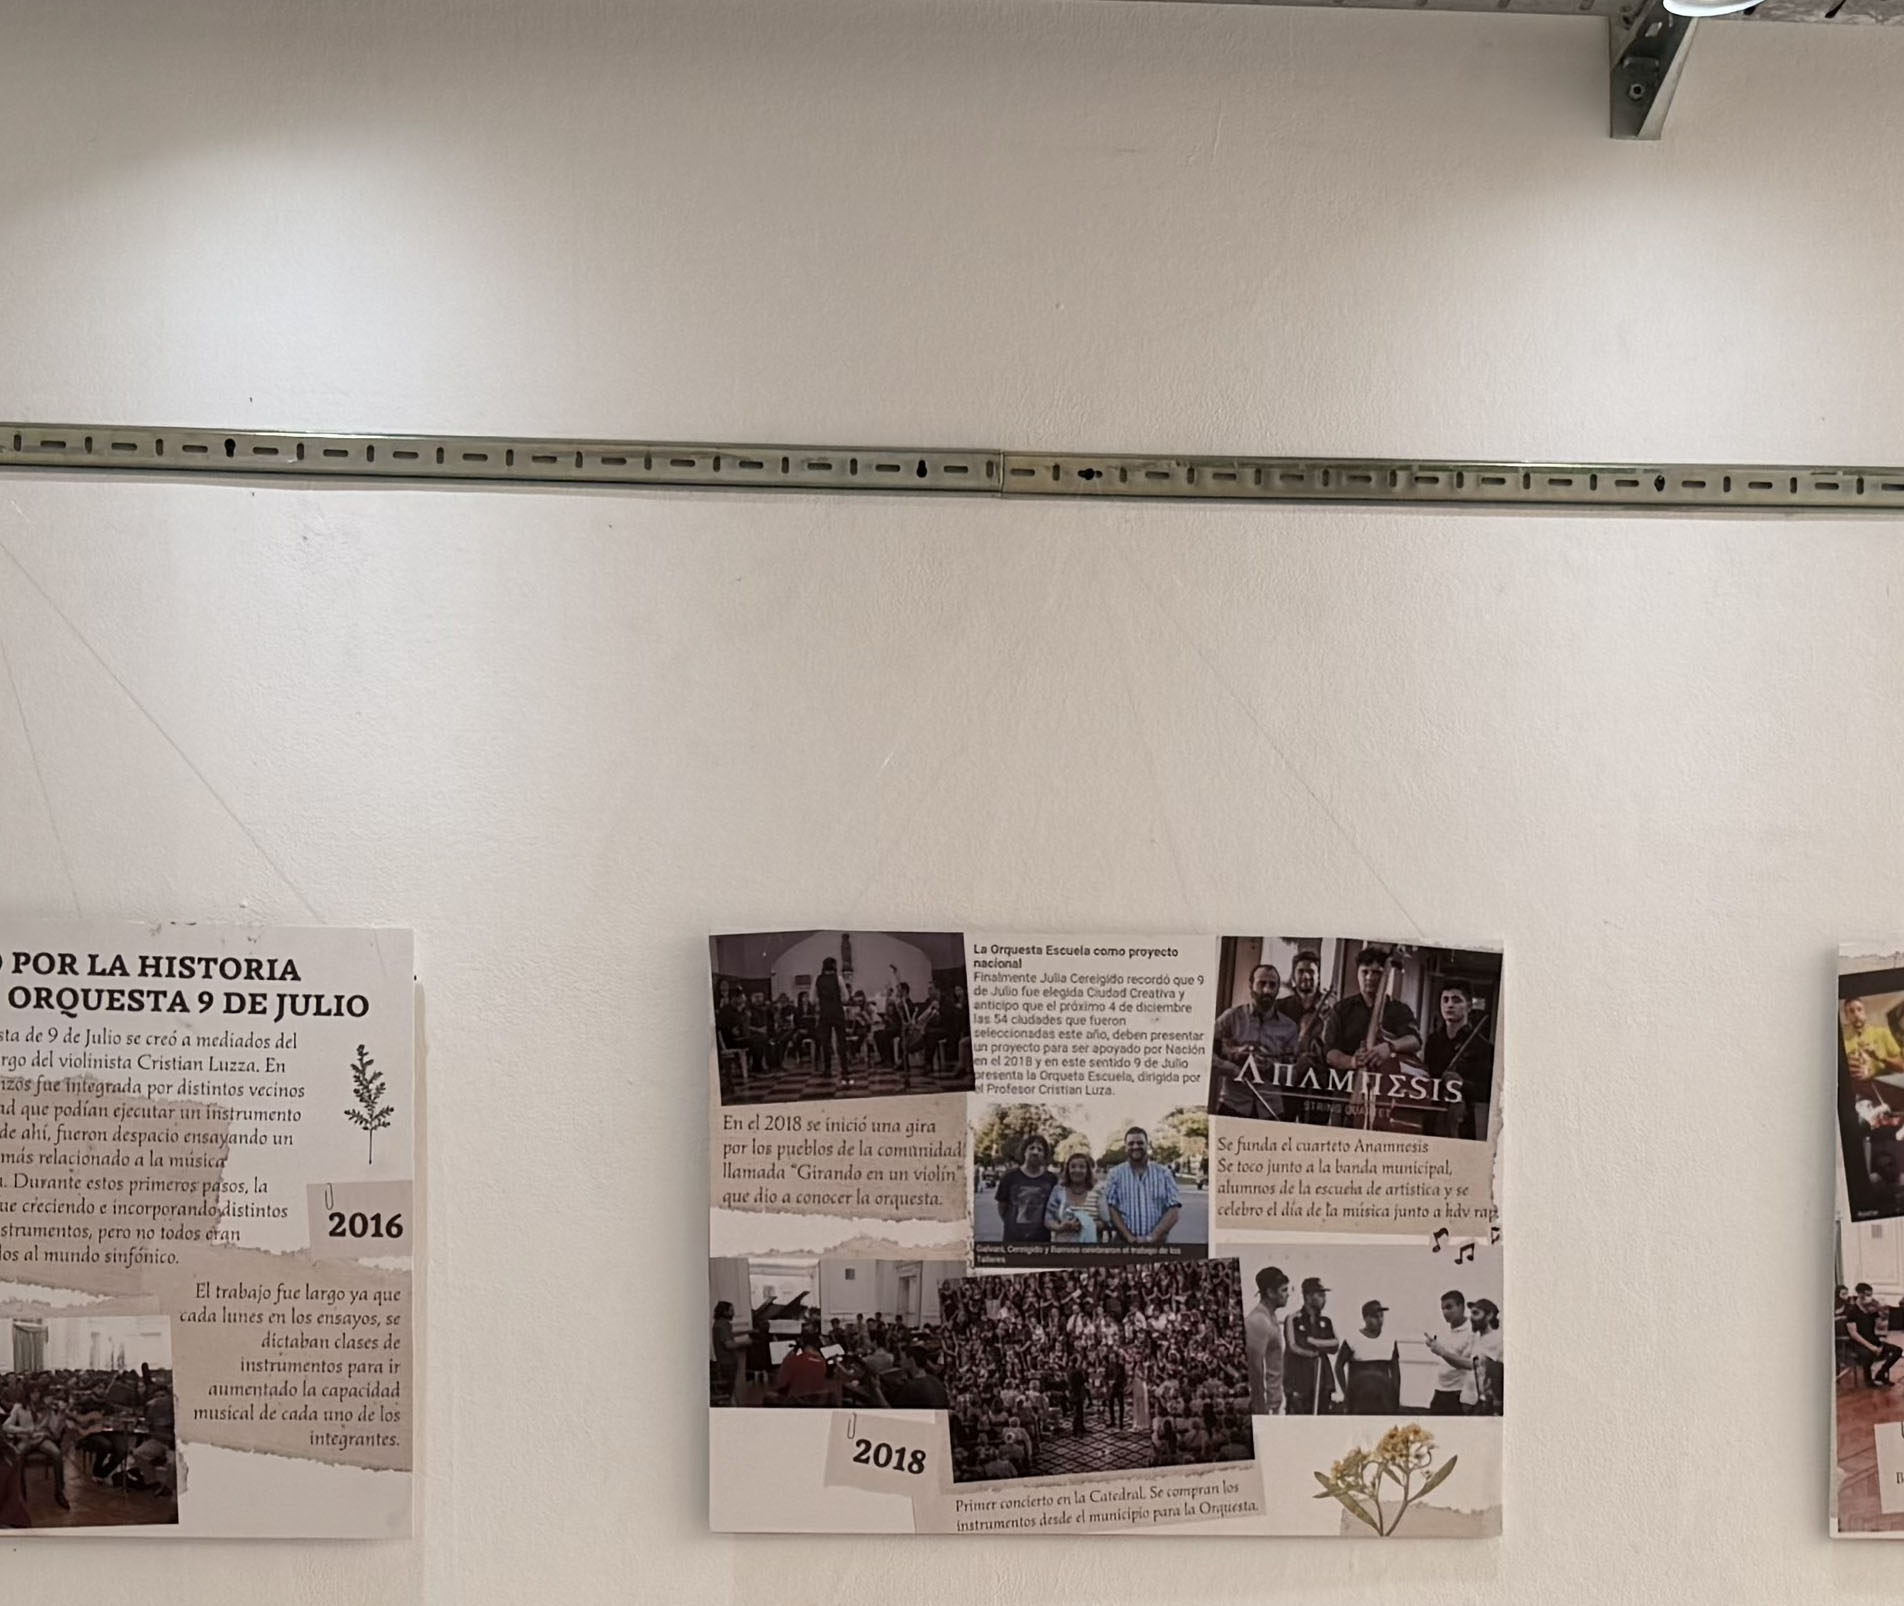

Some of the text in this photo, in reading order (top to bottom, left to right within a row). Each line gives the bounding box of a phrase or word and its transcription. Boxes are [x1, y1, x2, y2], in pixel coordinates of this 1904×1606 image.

[973, 943, 1179, 960] La Orquesta Escuela como proyecto
[973, 957, 1023, 969] nacional
[11, 951, 80, 976] POR
[87, 953, 131, 977] LA
[137, 955, 302, 982] HISTORIA
[7, 985, 370, 1024] ORQUESTA 9 DE JULIO
[25, 1025, 44, 1043] de
[47, 1026, 59, 1044] 9
[62, 1025, 81, 1044] de
[84, 1026, 122, 1049] Julio
[126, 1034, 142, 1046] se
[145, 1029, 178, 1047] creó
[181, 1035, 191, 1047] a
[196, 1029, 271, 1049] mediados
[275, 1031, 297, 1050] del
[31, 1049, 54, 1068] del
[58, 1050, 132, 1070] violinista
[136, 1053, 204, 1072] Cristian
[209, 1055, 260, 1073] Luzza.
[264, 1056, 286, 1073] En
[723, 1113, 936, 1139] En el 2018 se inició una gira
[723, 1143, 748, 1160] por
[752, 1137, 773, 1156] los
[777, 1138, 834, 1161] pueblos
[837, 1138, 855, 1157] de
[859, 1139, 873, 1157] la
[1217, 1136, 1430, 1157] Se funda el cuarteto Anamnesis
[328, 1211, 404, 1239] 2016
[195, 1280, 401, 1307] El trabajo fue largo ya que
[179, 1305, 401, 1331] cada lunes en los ensayos, se
[261, 1330, 401, 1350] dictaban clases de
[240, 1356, 401, 1379] instrumentos para ir
[208, 1379, 400, 1403] aumentado la capacidad
[193, 1402, 401, 1423] musical de cada uno de los
[309, 1430, 400, 1452] integrantes.
[852, 1438, 927, 1475] 2018
